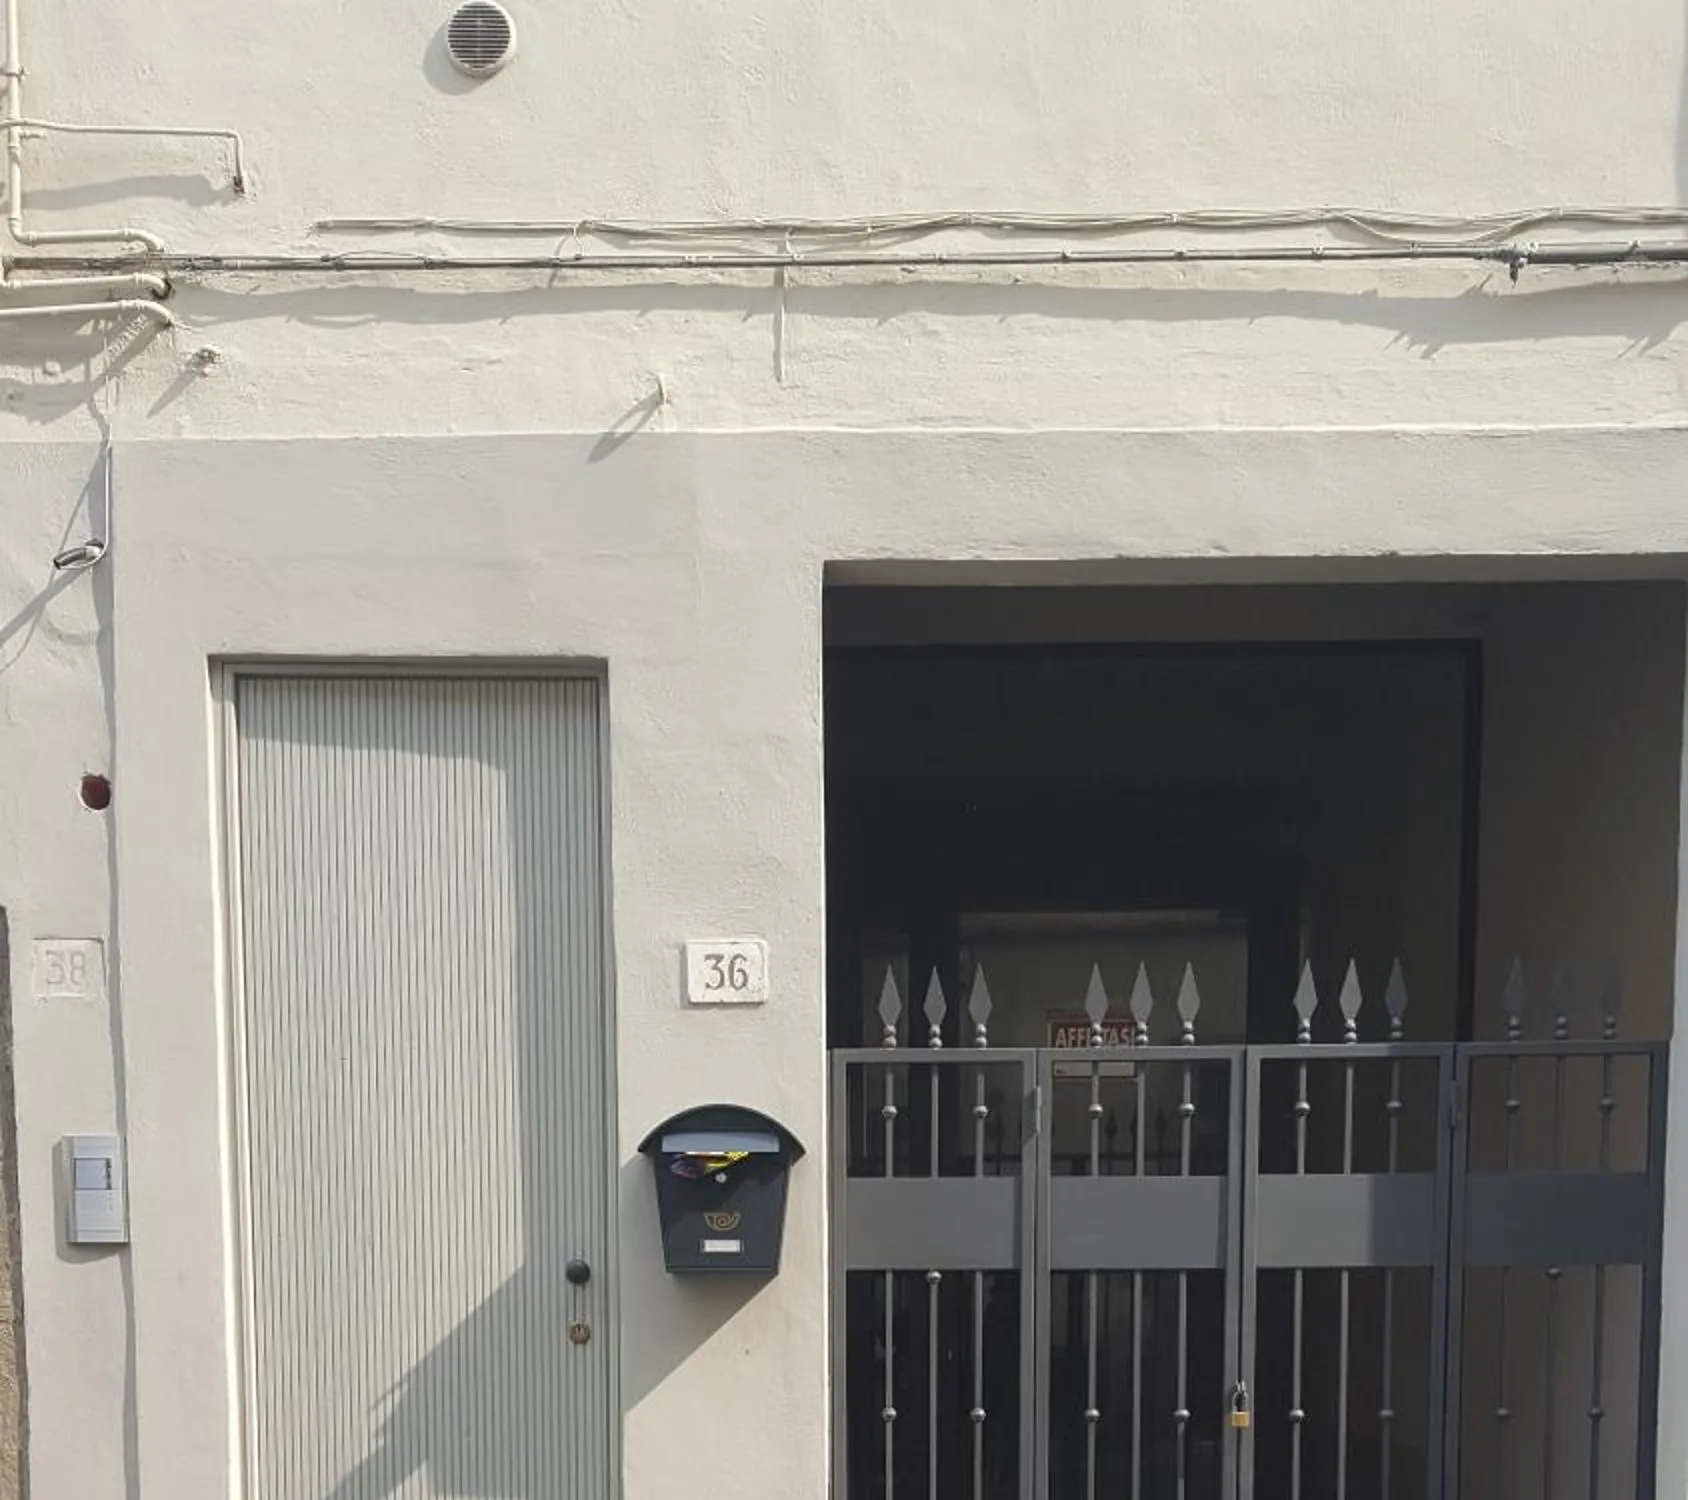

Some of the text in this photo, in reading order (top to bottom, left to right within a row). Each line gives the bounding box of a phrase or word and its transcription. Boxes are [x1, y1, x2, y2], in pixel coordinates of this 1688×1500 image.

[45, 949, 87, 988] 38
[704, 953, 749, 991] 36
[1055, 1026, 1135, 1048] AFFITASI
